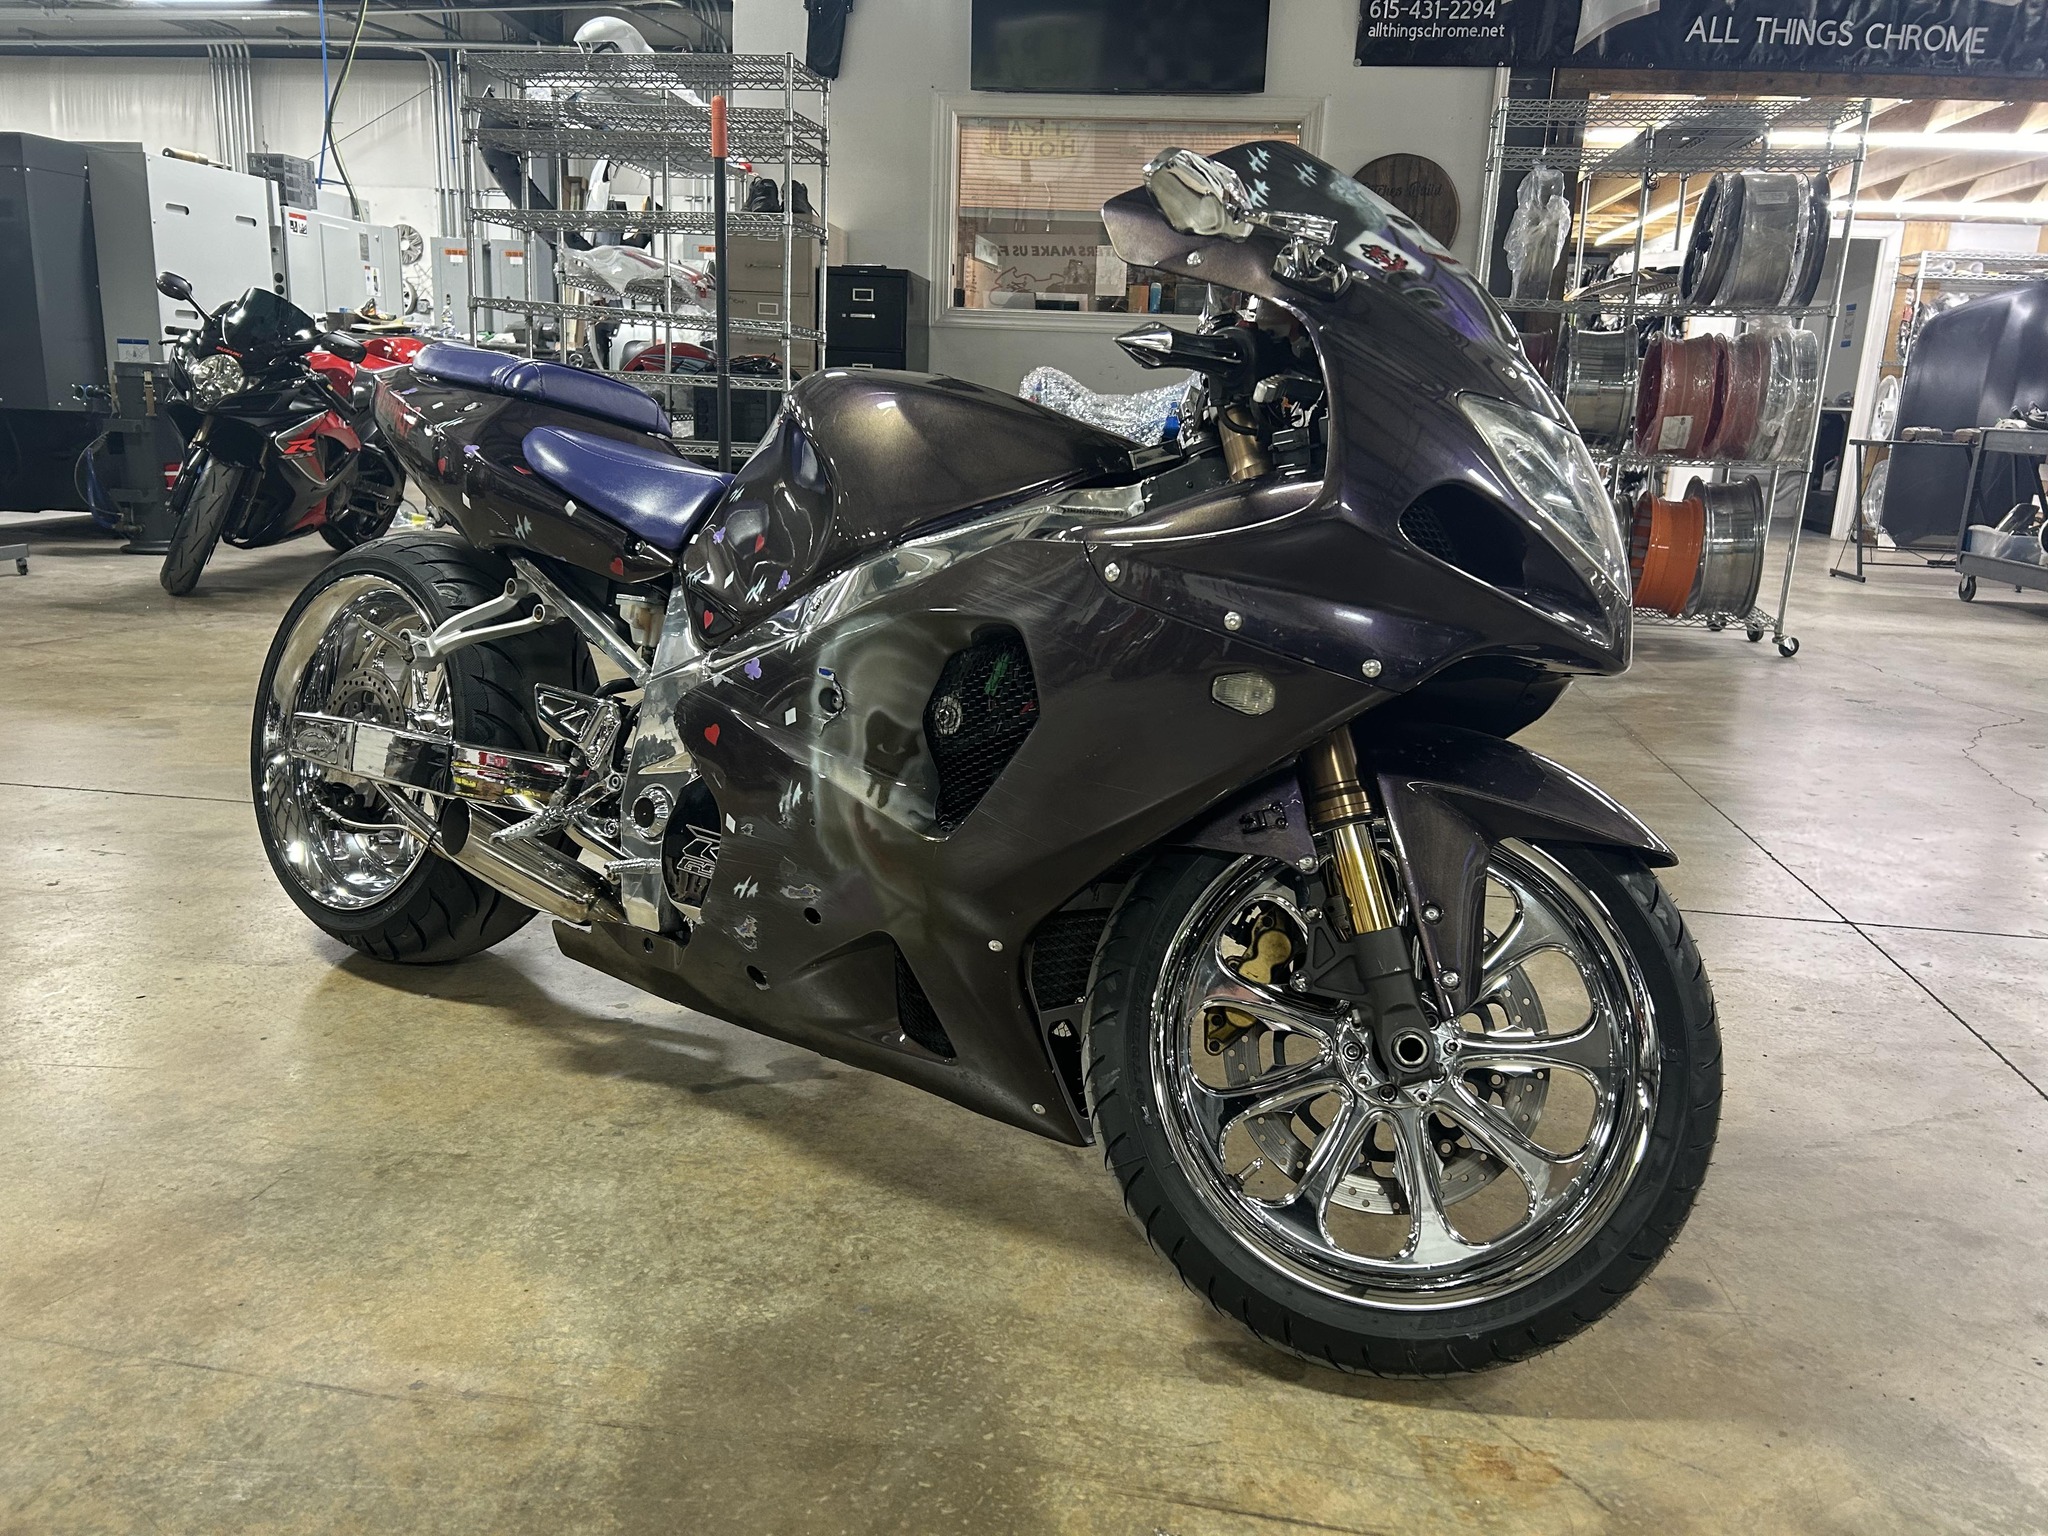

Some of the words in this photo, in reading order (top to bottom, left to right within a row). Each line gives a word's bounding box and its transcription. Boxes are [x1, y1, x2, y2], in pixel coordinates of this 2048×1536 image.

[1369, 0, 1496, 19] 615-431-2294
[1368, 22, 1506, 41] allthingschrome.net
[1684, 15, 1740, 43] ALL
[1756, 16, 1854, 46] THINGS
[1865, 22, 1989, 54] CHROME
